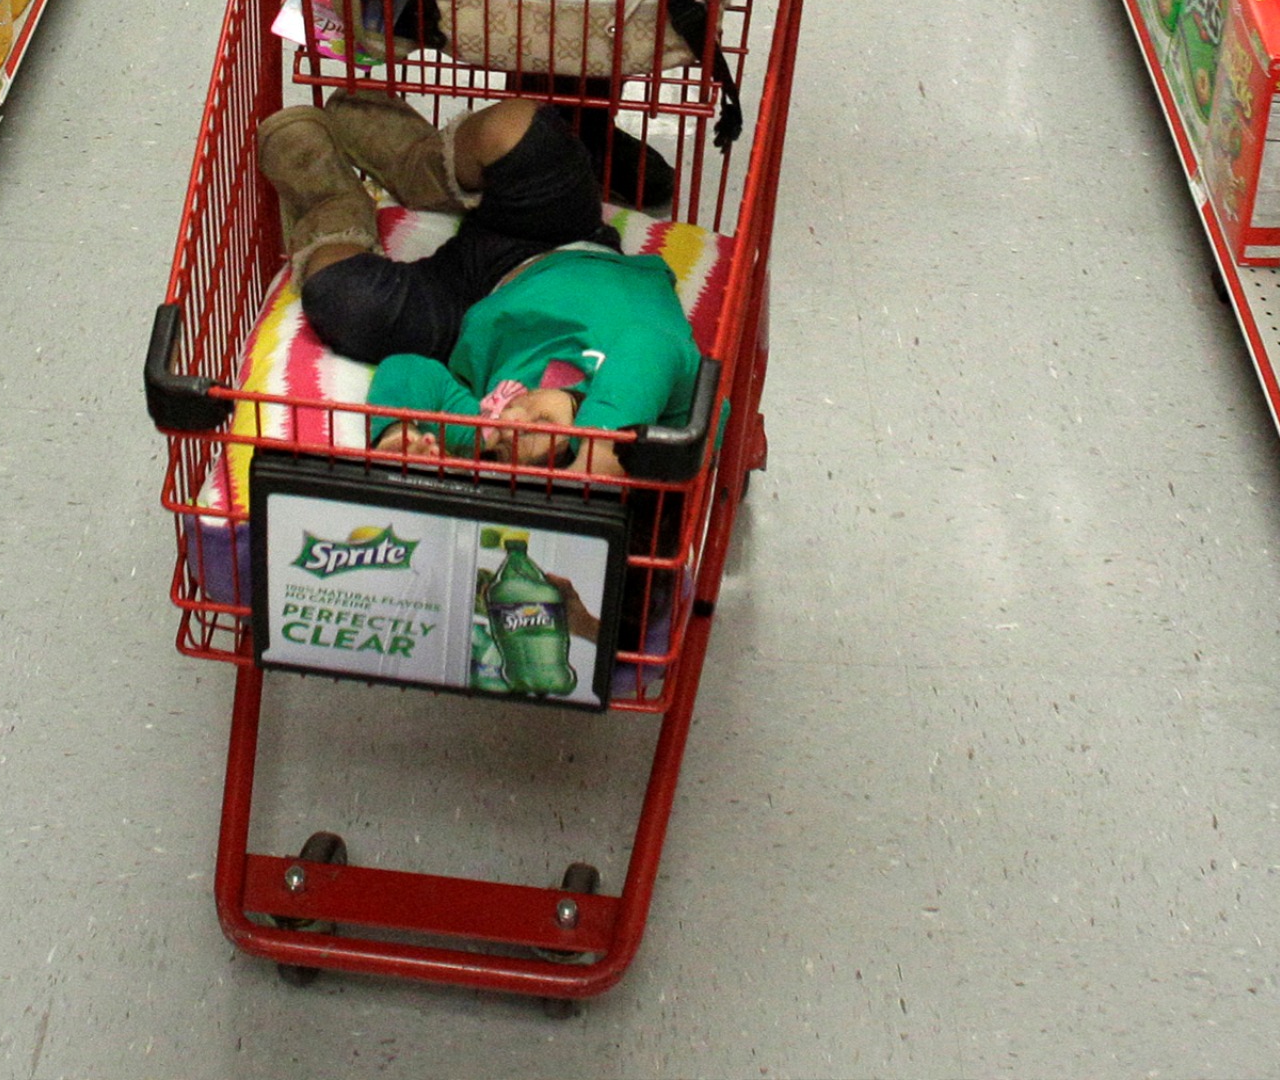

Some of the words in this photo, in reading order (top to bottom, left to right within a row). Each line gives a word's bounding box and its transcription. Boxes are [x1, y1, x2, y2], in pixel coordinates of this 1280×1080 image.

[305, 540, 406, 572] Sprite
[284, 591, 305, 600] NO
[307, 594, 371, 609] CAFFEINE
[318, 587, 377, 603] NATURAL
[381, 596, 442, 612] FLAVORS
[282, 604, 435, 637] PERFECTLY
[504, 612, 551, 631] Sprite
[282, 622, 416, 658] CLEAR
